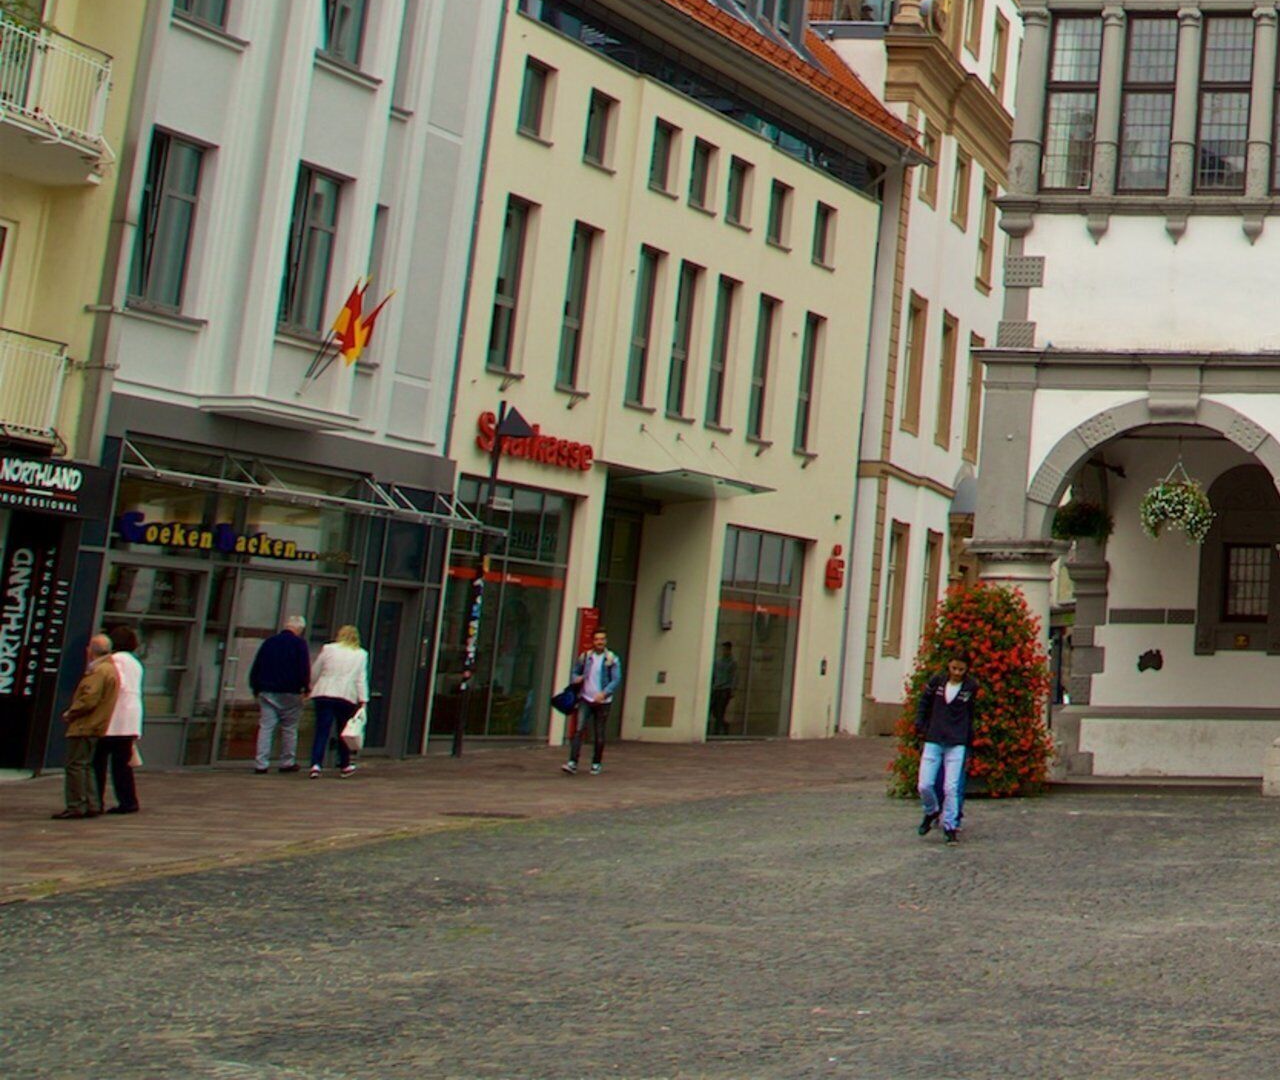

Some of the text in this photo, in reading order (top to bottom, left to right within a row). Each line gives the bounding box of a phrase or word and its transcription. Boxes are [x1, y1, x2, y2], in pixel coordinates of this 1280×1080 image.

[476, 411, 593, 471] Sarkasse
[0, 458, 82, 492] NORTHLAND
[0, 493, 78, 512] ROFESSIONAL
[0, 548, 34, 694] NORTHLAND
